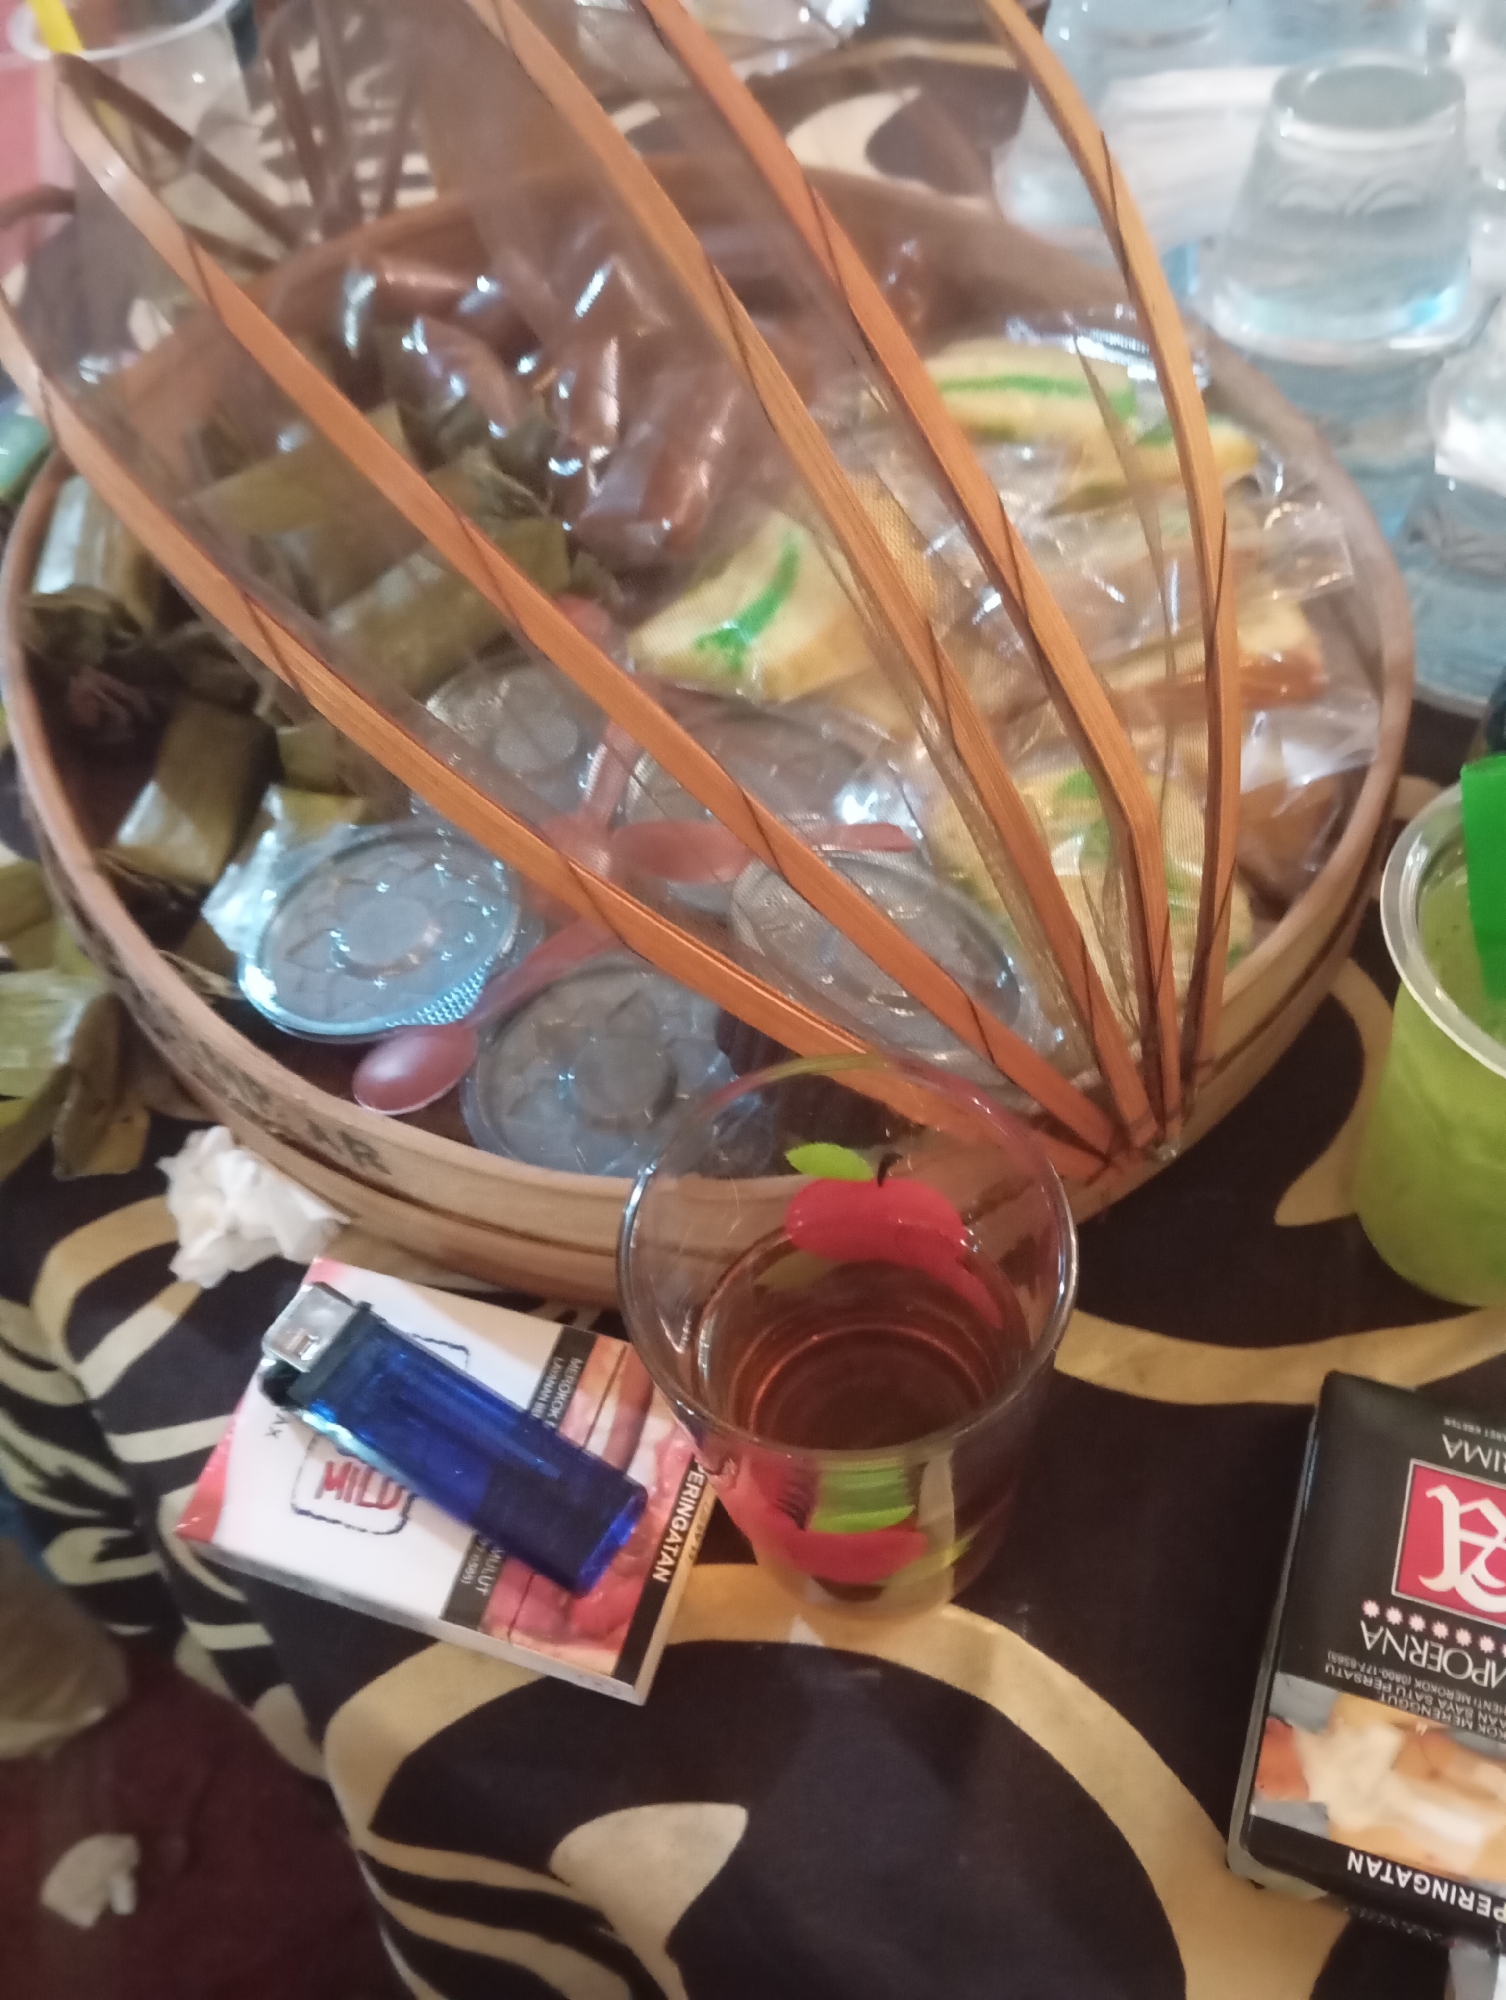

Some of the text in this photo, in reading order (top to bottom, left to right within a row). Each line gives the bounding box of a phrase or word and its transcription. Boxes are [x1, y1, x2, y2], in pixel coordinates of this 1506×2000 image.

[314, 1460, 405, 1510] MILD
[1325, 1663, 1392, 1693] PERSATU
[1415, 1677, 1472, 1705] MEROKOK
[1396, 1686, 1433, 1706] SATU
[1437, 1698, 1474, 1719] SAYA
[1347, 1850, 1506, 1925] PERINGATAN
